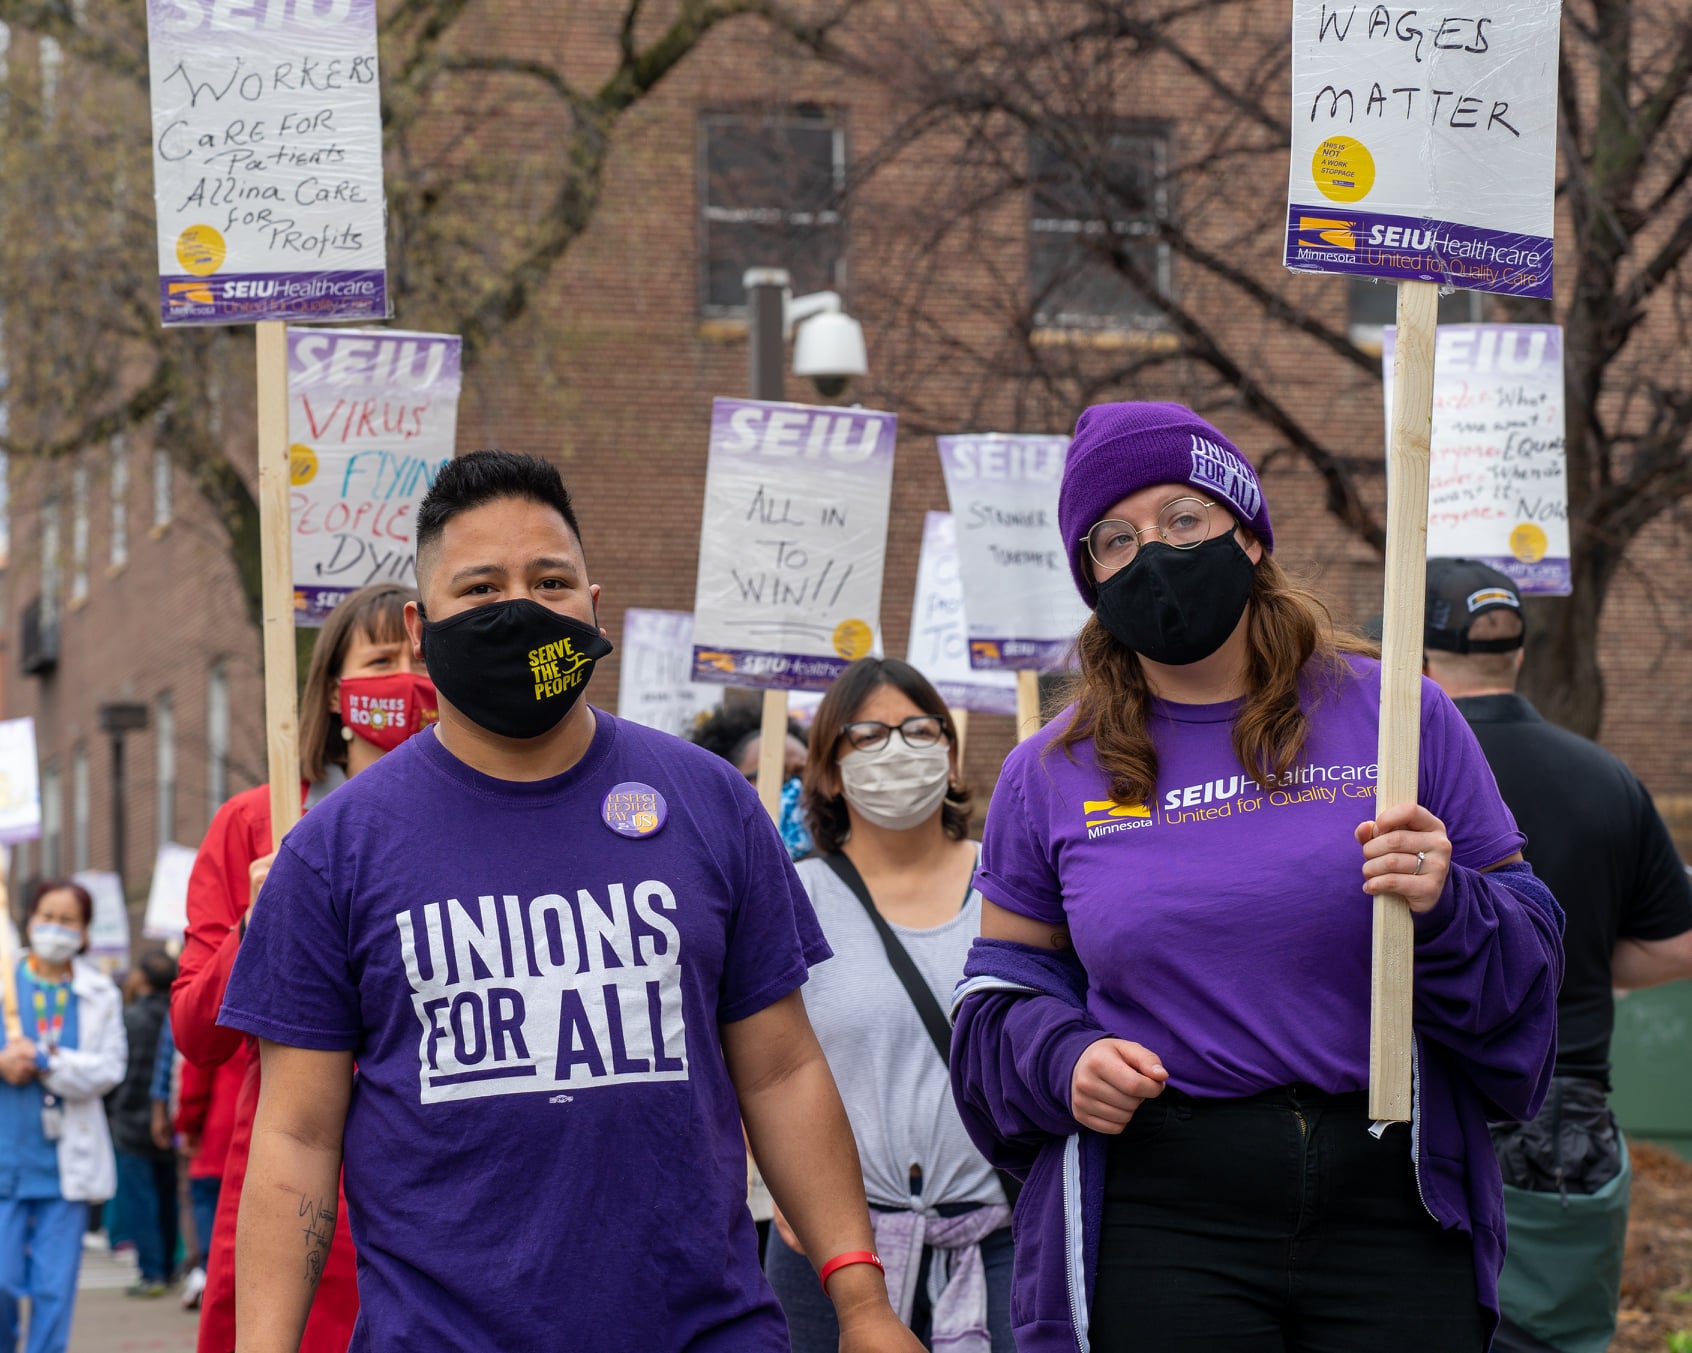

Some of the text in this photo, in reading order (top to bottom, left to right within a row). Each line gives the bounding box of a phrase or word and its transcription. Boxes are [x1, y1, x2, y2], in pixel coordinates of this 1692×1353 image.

[1318, 4, 1492, 62] WAGES
[162, 56, 375, 107] WORKERS
[278, 109, 337, 137] FOR
[1310, 82, 1520, 137] MATTER
[1320, 168, 1356, 178] STOPPAGE
[1322, 149, 1341, 158] NOT
[1327, 159, 1348, 168] WORK
[1297, 248, 1356, 264] Minnesota
[1367, 248, 1539, 288] United for Quality Care
[290, 336, 448, 387] SEIU
[1437, 329, 1547, 374] EIU
[301, 393, 430, 444] VIRUS
[721, 407, 883, 463] SEIU
[952, 442, 1062, 482] SEIU
[747, 483, 846, 528] ALL IN
[1194, 453, 1256, 519] FOR ALL
[755, 540, 809, 570] TO
[731, 559, 854, 618] WIN!!
[528, 636, 575, 667] SERVE
[531, 660, 561, 683] THE
[349, 694, 405, 710] IT TAKES
[534, 668, 585, 701] PEOPLE
[607, 811, 627, 822] PAY
[631, 814, 653, 827] US
[1166, 802, 1232, 825] United
[1237, 797, 1263, 813] for
[1269, 785, 1337, 806] Quality
[1087, 818, 1153, 840] Minnesota
[395, 879, 682, 994] UNIONS
[422, 979, 684, 1081] FOR ALL
